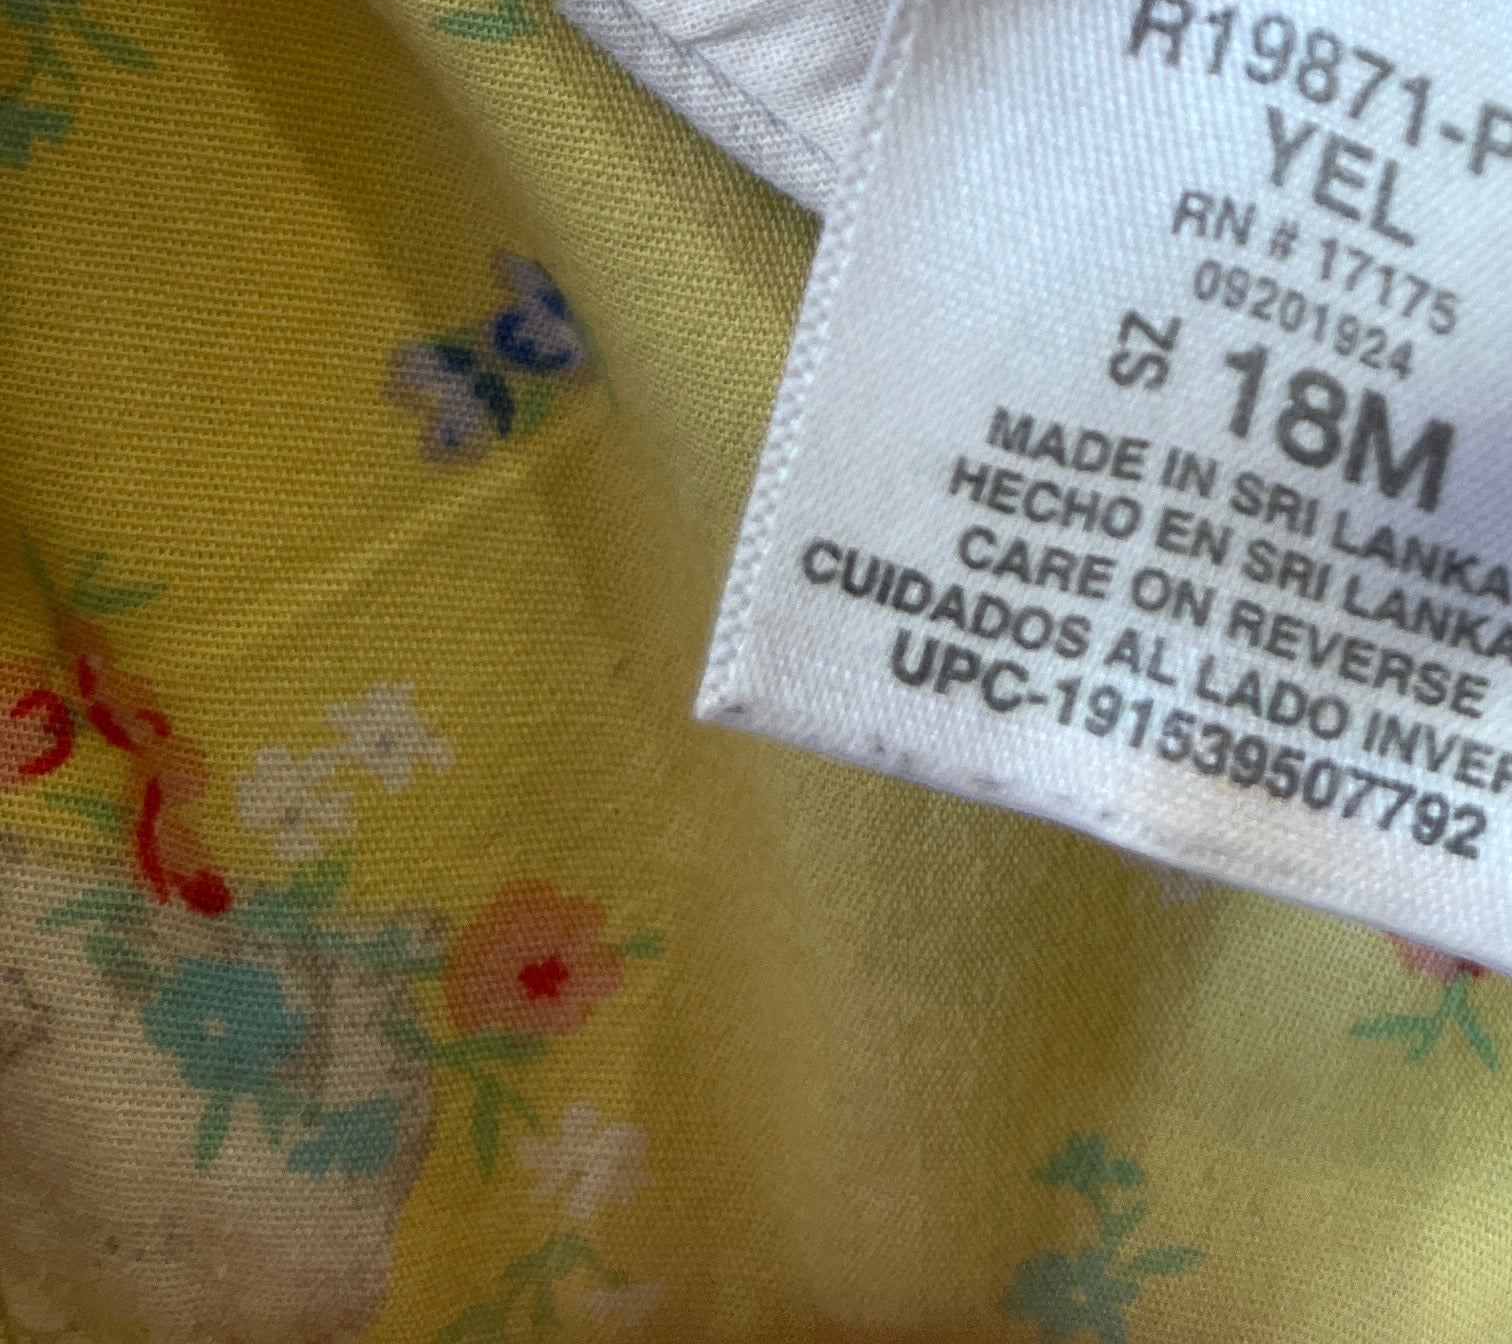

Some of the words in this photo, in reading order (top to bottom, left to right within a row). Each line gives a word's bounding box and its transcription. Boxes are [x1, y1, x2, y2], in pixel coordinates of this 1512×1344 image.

[1265, 105, 1417, 249] YEL
[1170, 188, 1257, 246] RN
[1267, 220, 1300, 261] #
[1317, 236, 1461, 338] 17175
[1193, 257, 1416, 381] 09201924
[1107, 307, 1183, 393] SZ
[986, 405, 1150, 484] MADE
[1161, 445, 1219, 499] IN
[1229, 470, 1321, 540] SRI
[1223, 342, 1456, 515] 18M
[947, 455, 1142, 543] HECHO
[1154, 507, 1231, 570] EN
[1240, 534, 1330, 604] SRI
[802, 537, 1092, 660] CUIDADOS
[1104, 625, 1180, 687] AL
[1195, 652, 1351, 742] LADO
[956, 523, 1117, 603] CARE
[1129, 565, 1215, 630] ON
[1226, 594, 1494, 721] REVERSE
[889, 628, 1489, 863] UPC-191539507792
